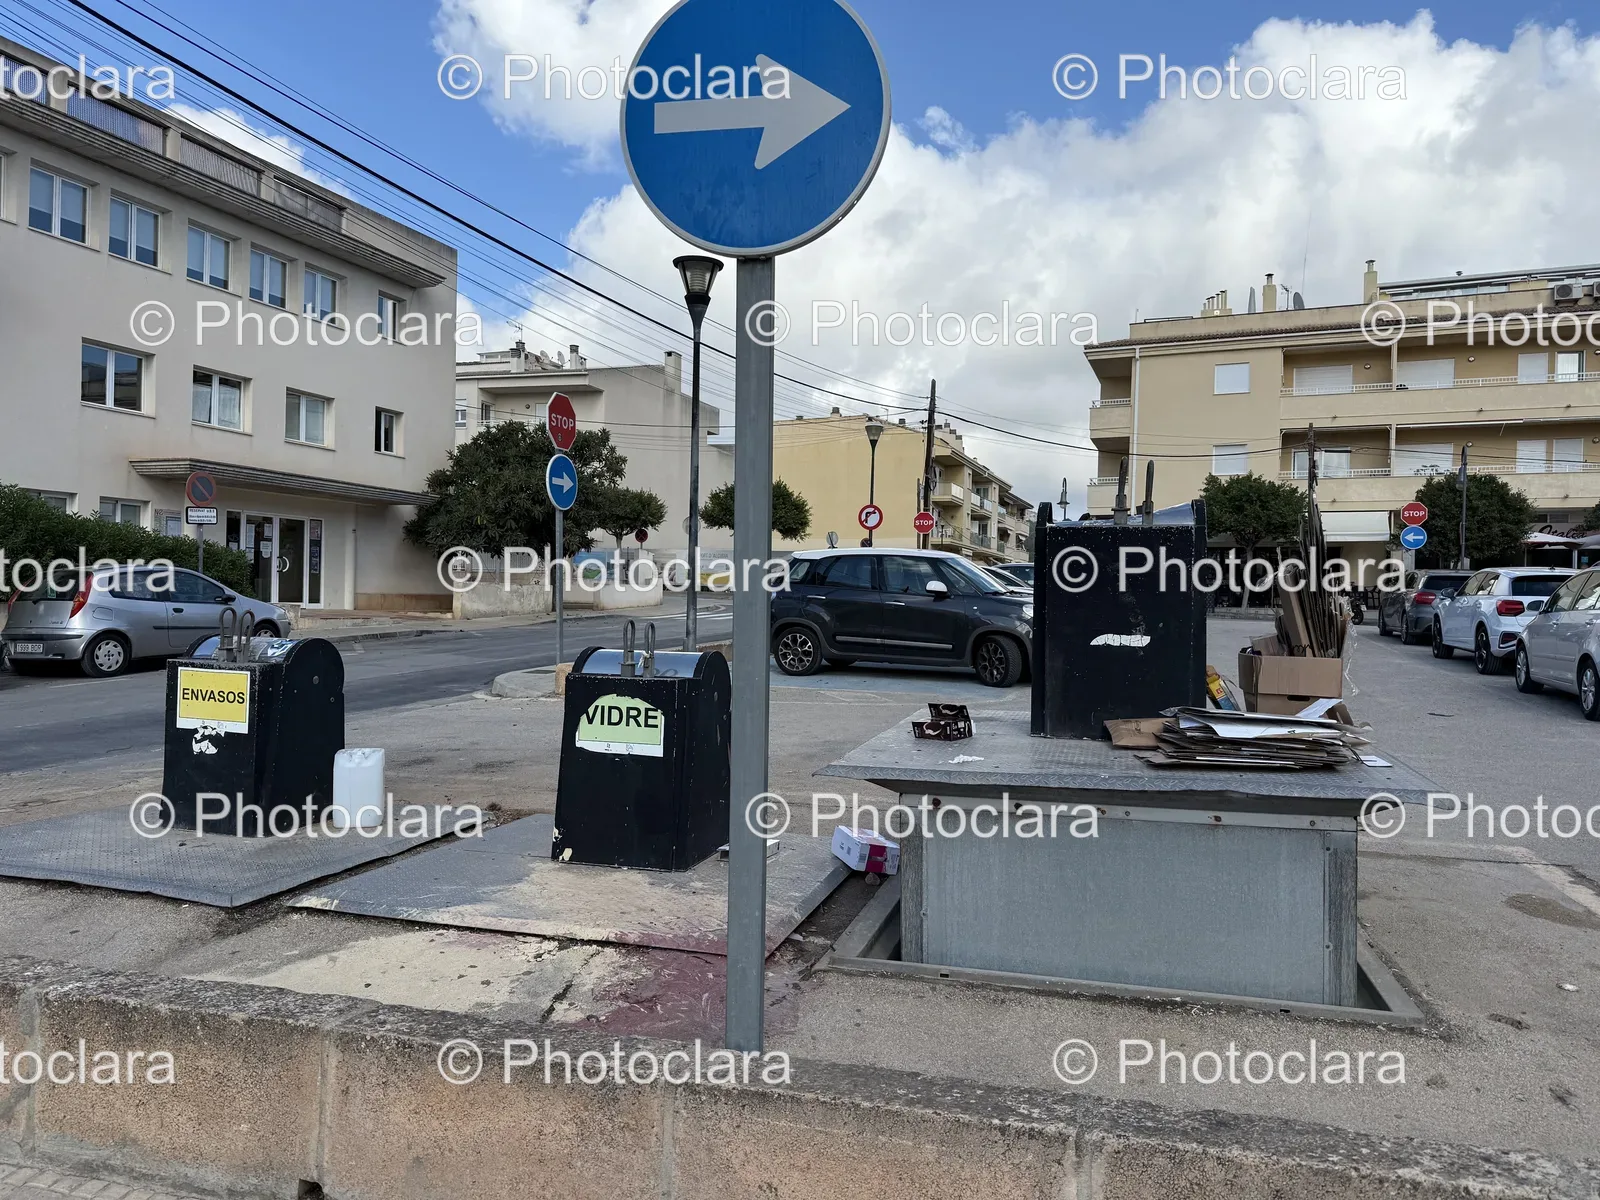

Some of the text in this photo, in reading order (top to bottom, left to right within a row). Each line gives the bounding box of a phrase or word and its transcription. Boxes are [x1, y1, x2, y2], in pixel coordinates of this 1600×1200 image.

[551, 413, 575, 430] STOP
[182, 688, 245, 704] ENVASOS
[585, 705, 659, 728] VIDRE
